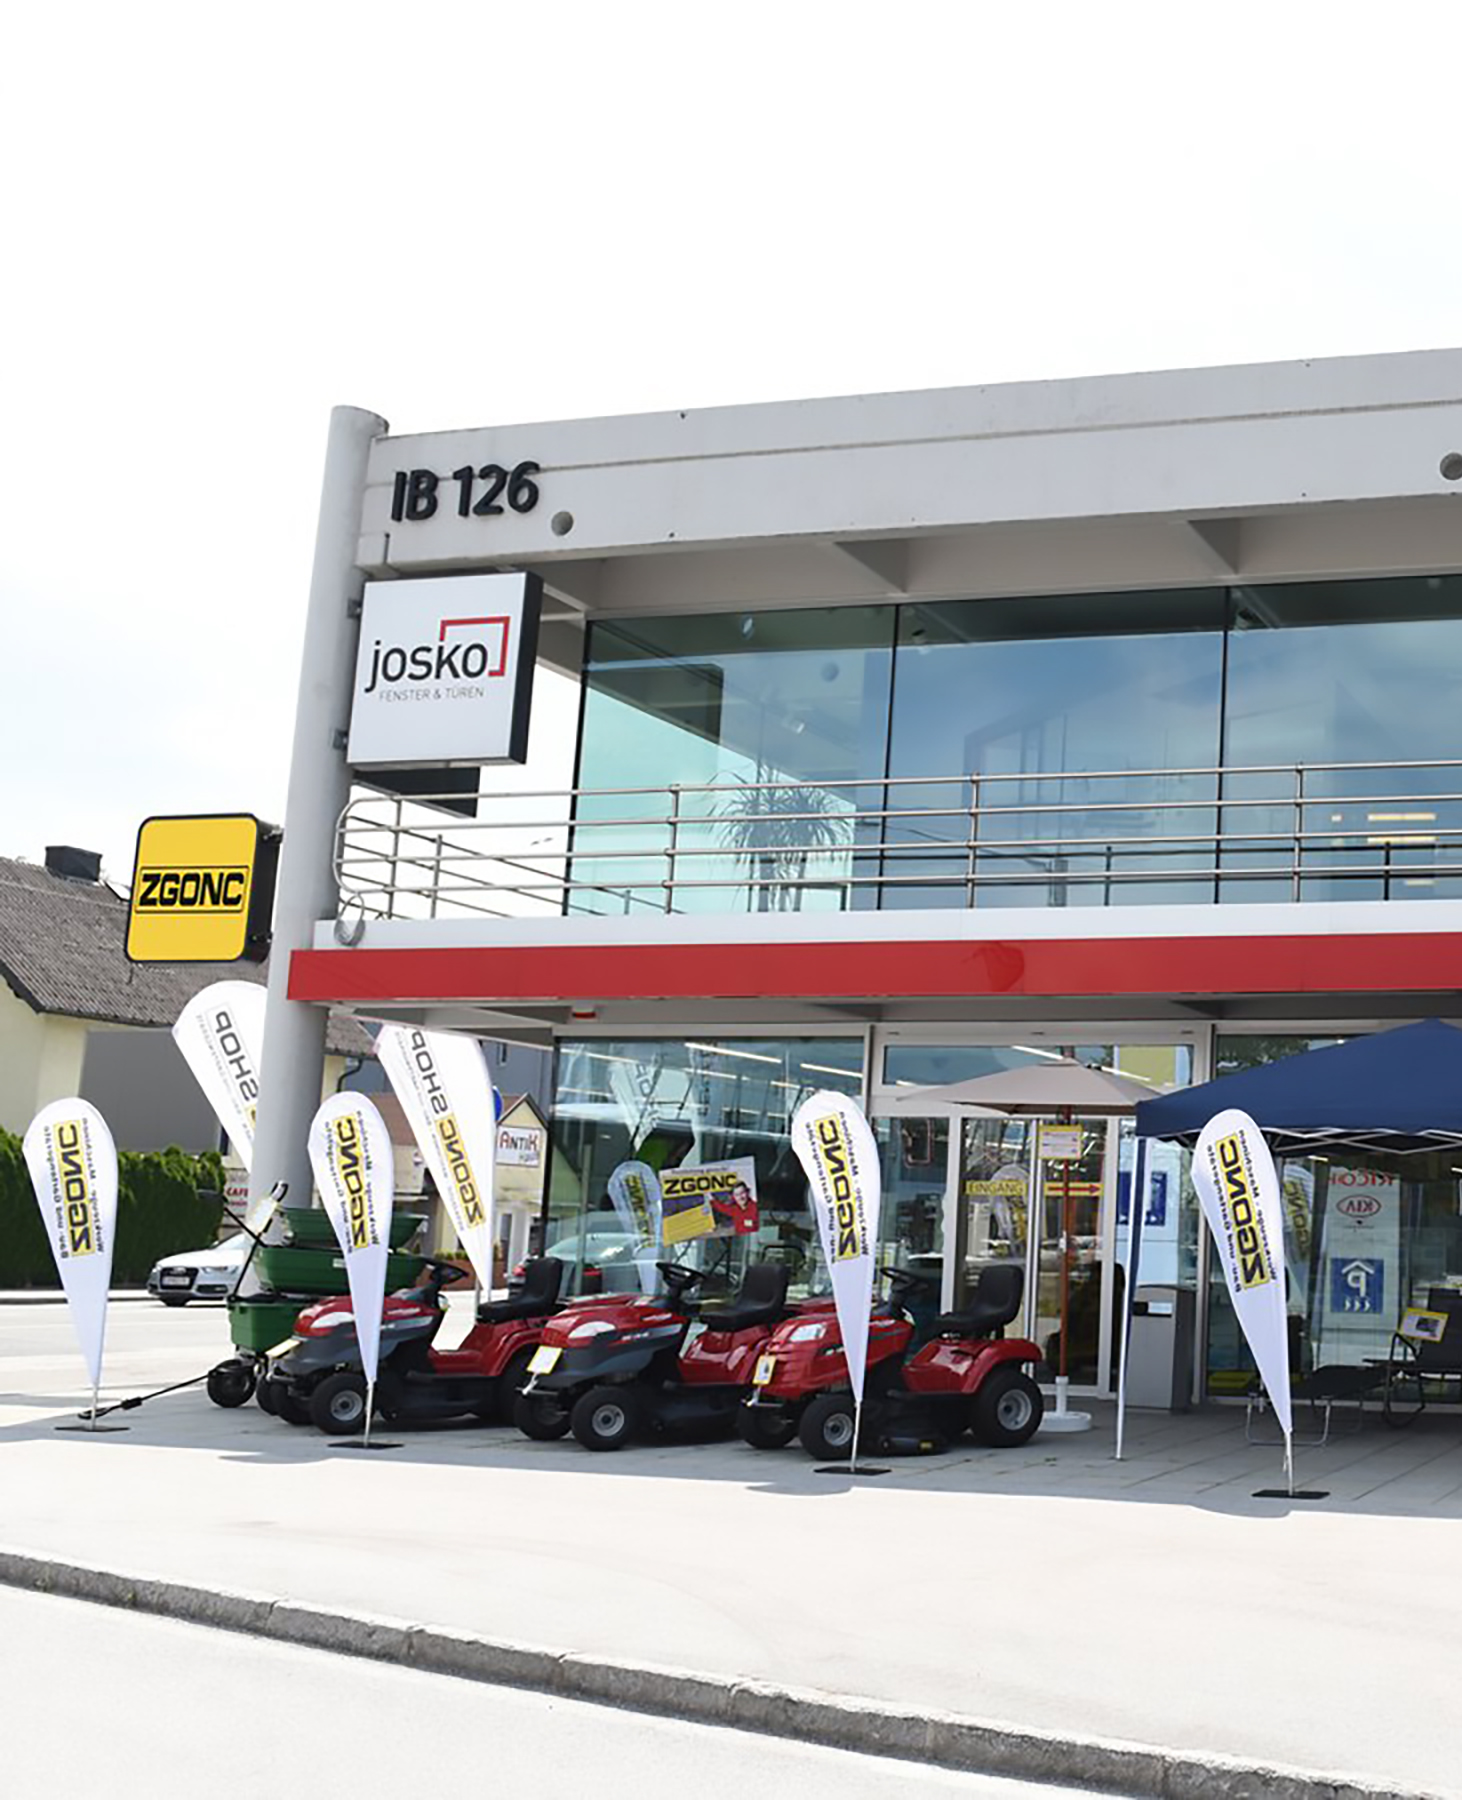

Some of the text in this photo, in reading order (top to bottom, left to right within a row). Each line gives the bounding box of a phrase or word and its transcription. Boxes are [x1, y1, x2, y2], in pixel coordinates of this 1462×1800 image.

[391, 461, 540, 522] IB 126
[364, 640, 488, 692] josko
[380, 686, 484, 702] FENSTER & TÜREN
[139, 873, 245, 906] ZGONC
[664, 1174, 736, 1195] ZGONC
[969, 1183, 1023, 1194] EINGANG
